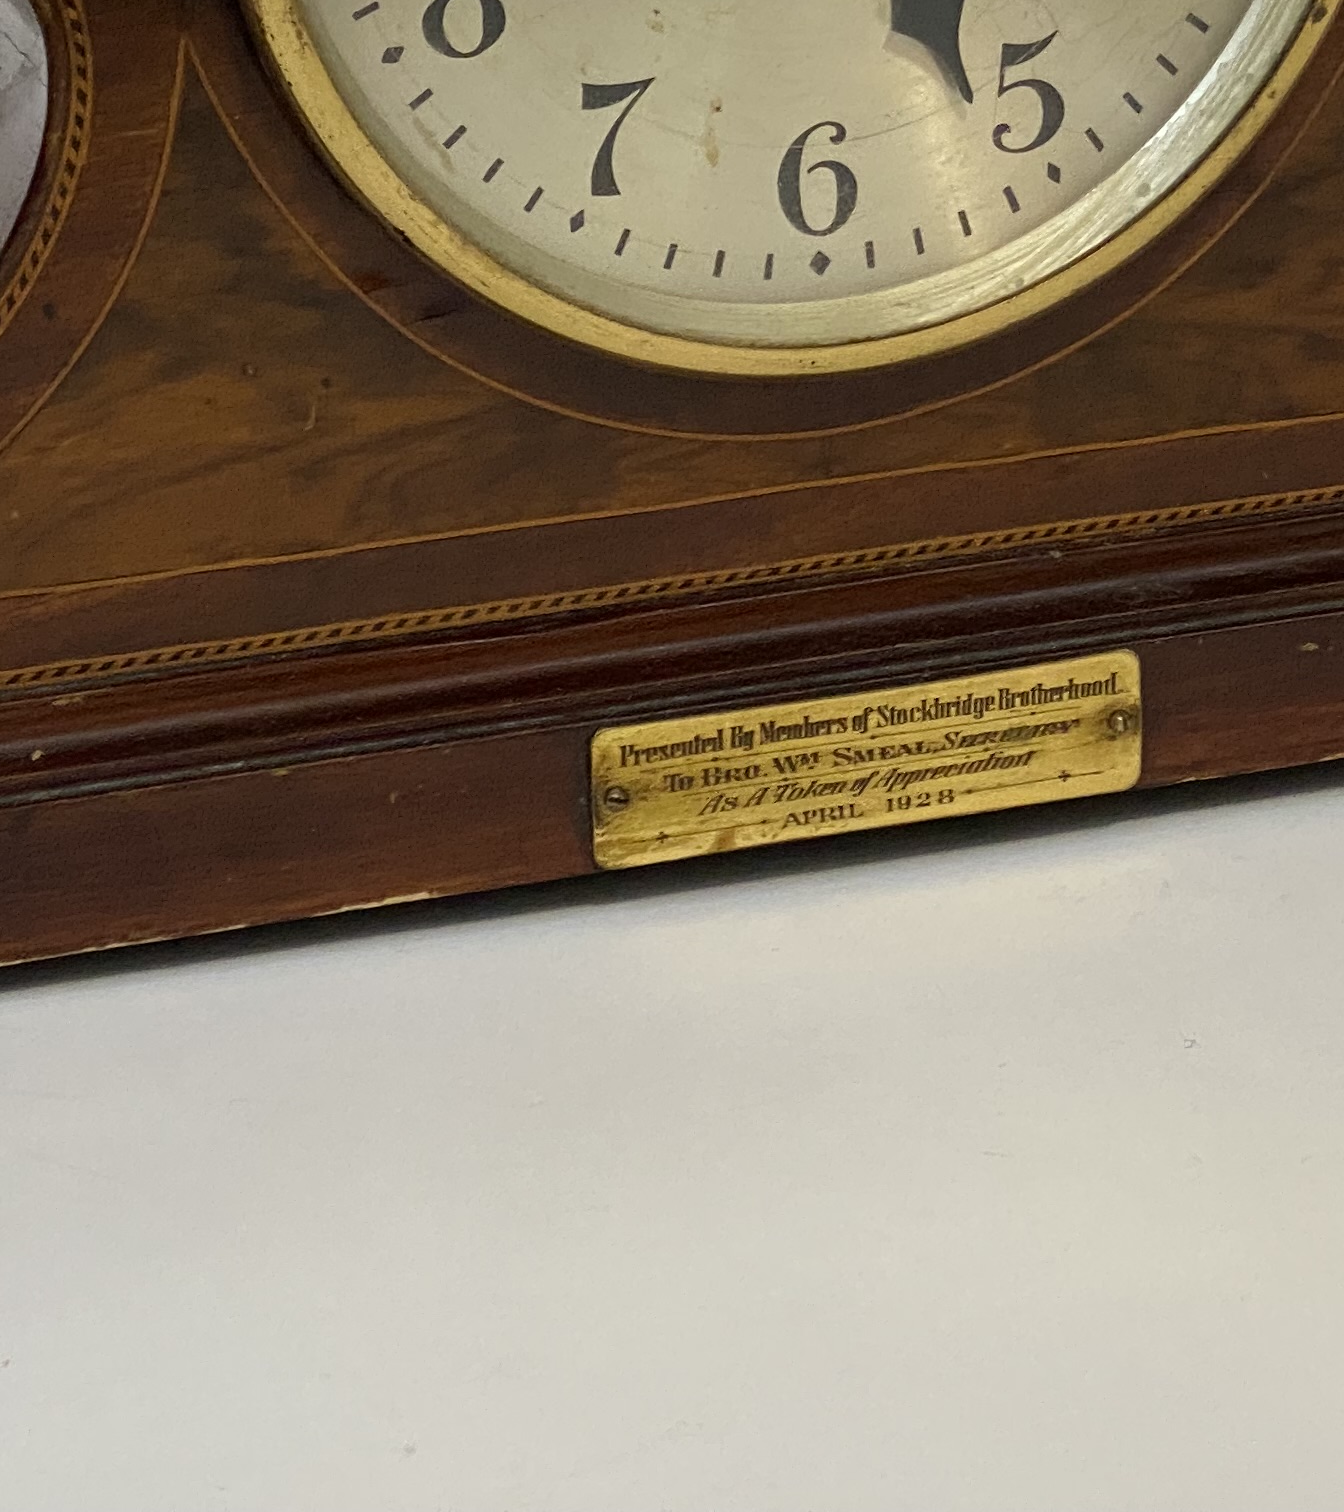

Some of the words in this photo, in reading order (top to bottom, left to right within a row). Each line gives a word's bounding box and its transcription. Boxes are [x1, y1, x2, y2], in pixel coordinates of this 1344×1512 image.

[991, 31, 1064, 154] 5
[581, 77, 655, 197] 7
[776, 121, 858, 236] 6
[620, 728, 725, 768] Presented
[730, 725, 755, 751] By
[759, 715, 849, 746] Members
[852, 706, 873, 733] of
[876, 693, 996, 728] Stockbridge
[663, 772, 694, 792] To
[697, 793, 739, 816] As
[743, 787, 771, 809] A
[772, 778, 848, 804] Token
[848, 770, 880, 797] of
[878, 749, 1040, 792] Appreciation
[781, 802, 865, 829] APRIL
[886, 788, 955, 813] 1928
